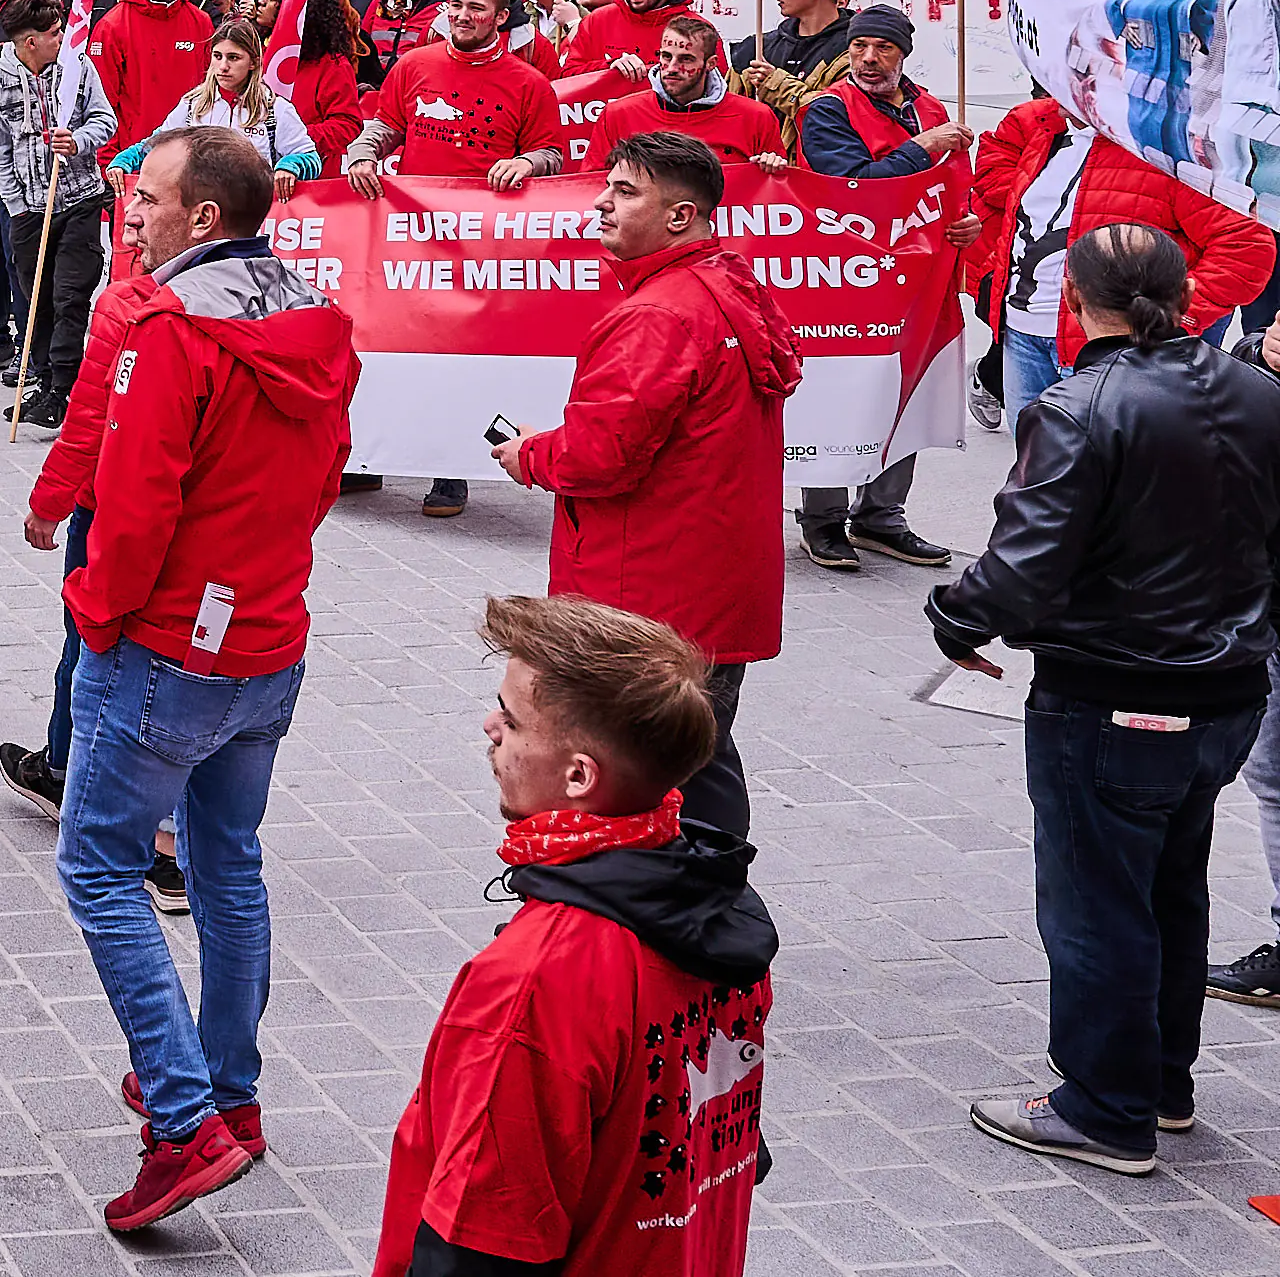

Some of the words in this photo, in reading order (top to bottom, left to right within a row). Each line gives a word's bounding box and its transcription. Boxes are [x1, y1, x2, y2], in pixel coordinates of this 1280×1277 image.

[385, 210, 484, 242] EURE
[493, 210, 602, 240] HERZ
[816, 207, 875, 241] SO
[383, 259, 454, 291] WIE
[462, 259, 600, 291] MEINE
[731, 1080, 763, 1115] uni
